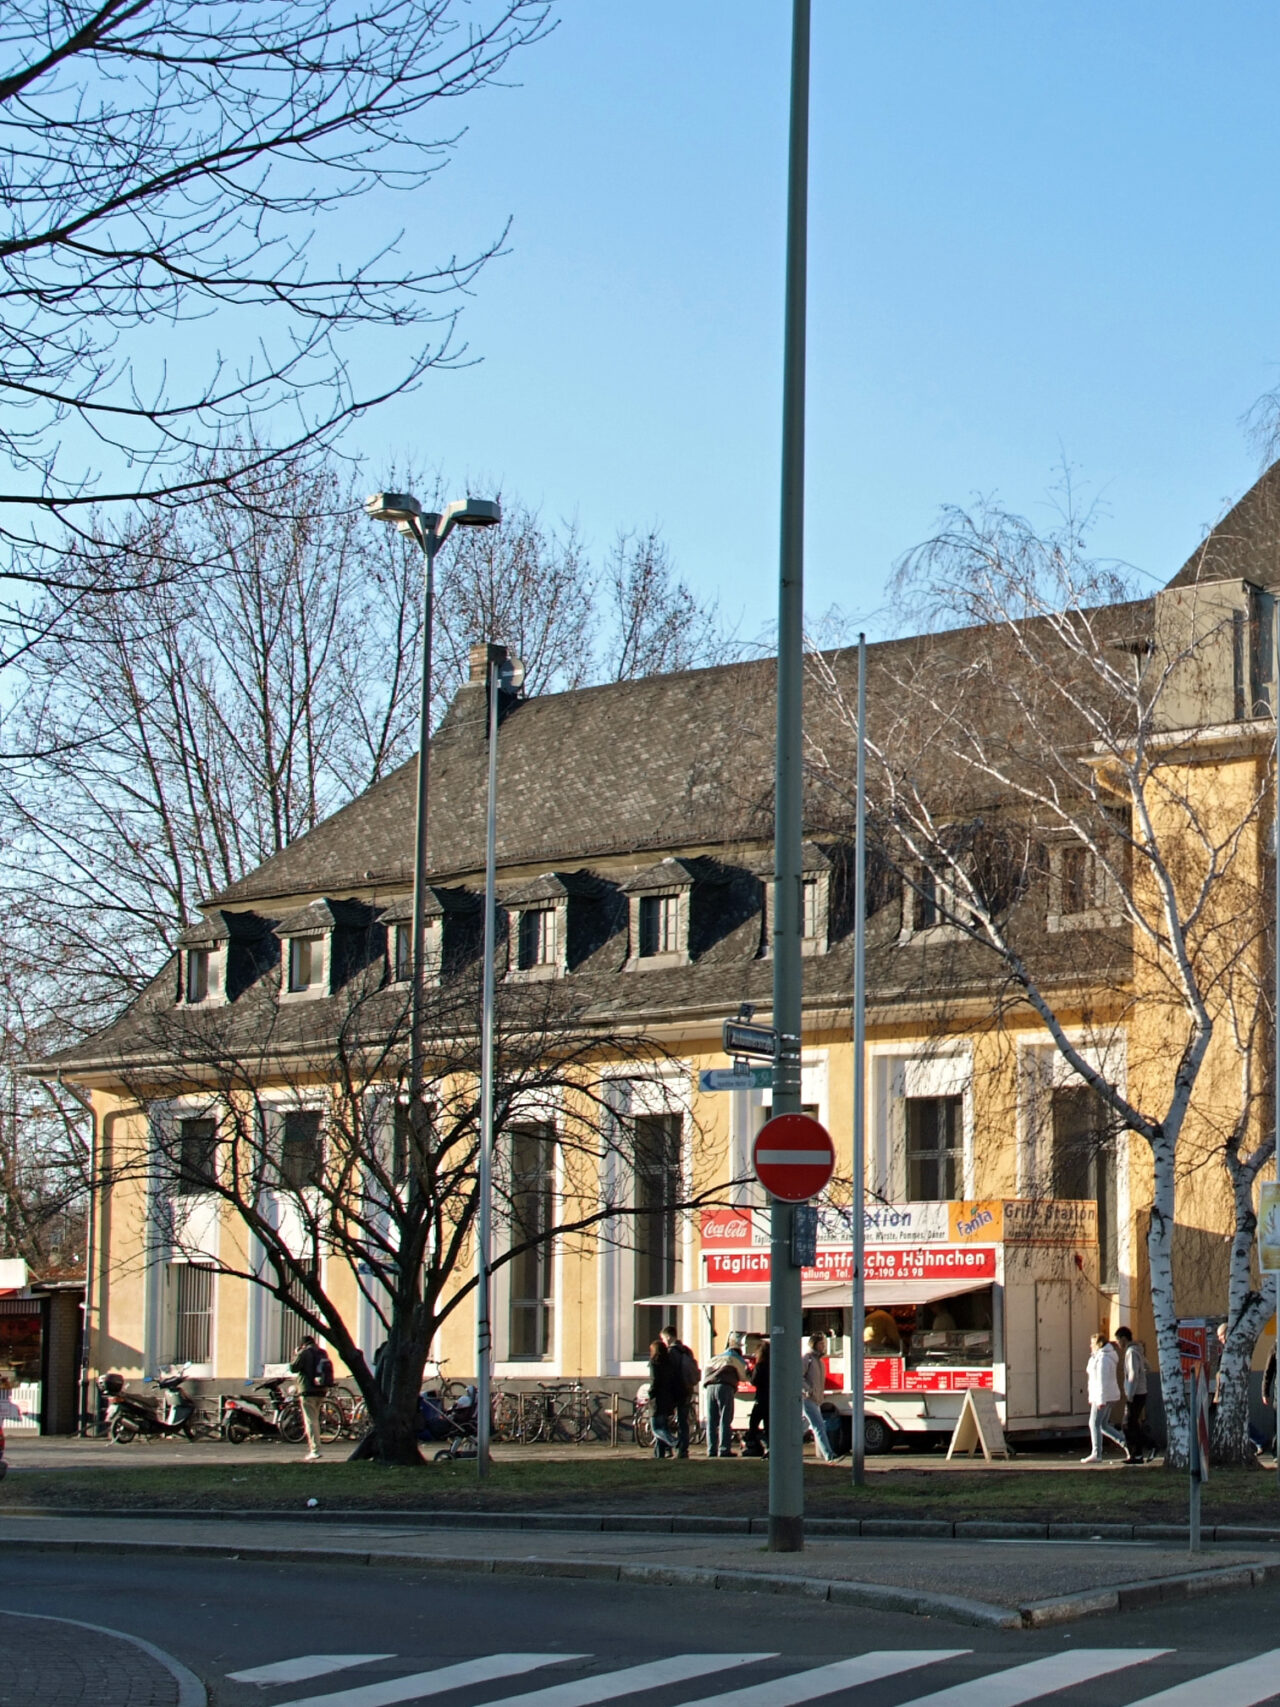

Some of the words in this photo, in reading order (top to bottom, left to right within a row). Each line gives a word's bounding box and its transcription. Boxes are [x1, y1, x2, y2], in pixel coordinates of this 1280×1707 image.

[956, 1210, 993, 1238] Fanta
[713, 1255, 769, 1274] Täglich
[902, 1249, 986, 1267] Hähnchen
[836, 1268, 851, 1279] Tel.
[897, 1267, 909, 1277] 63
[911, 1266, 924, 1277] 98
